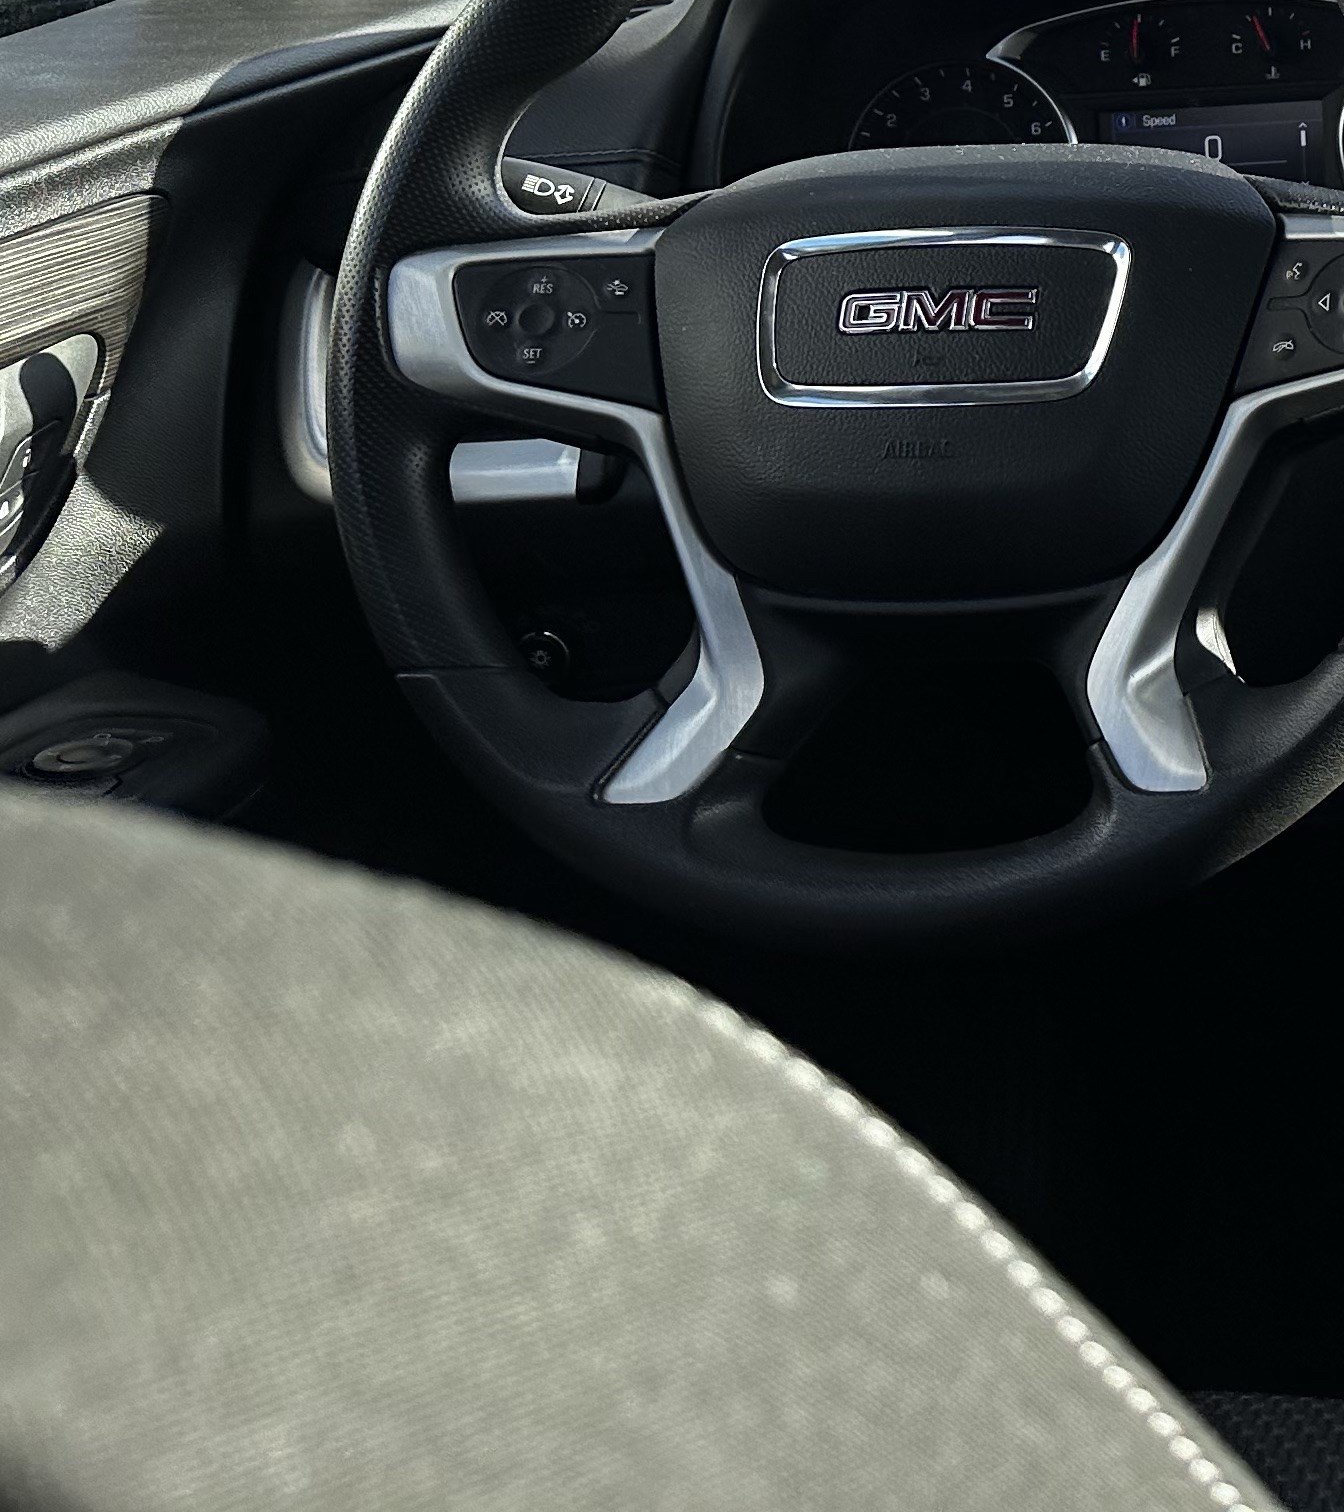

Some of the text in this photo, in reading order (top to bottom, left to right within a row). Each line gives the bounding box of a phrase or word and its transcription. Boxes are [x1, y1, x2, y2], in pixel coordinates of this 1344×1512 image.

[1170, 44, 1180, 58] F
[1231, 42, 1242, 54] C
[1300, 38, 1311, 50] H
[1100, 48, 1110, 62] E
[961, 79, 972, 93] 4
[920, 87, 931, 102] 3
[1003, 93, 1014, 108] 5
[886, 113, 897, 128] 2
[1141, 112, 1176, 129] Speed
[1030, 121, 1041, 136] 6
[1204, 134, 1222, 162] 0
[532, 282, 553, 295] RES
[839, 288, 1037, 333] GMC
[522, 347, 542, 360] SET
